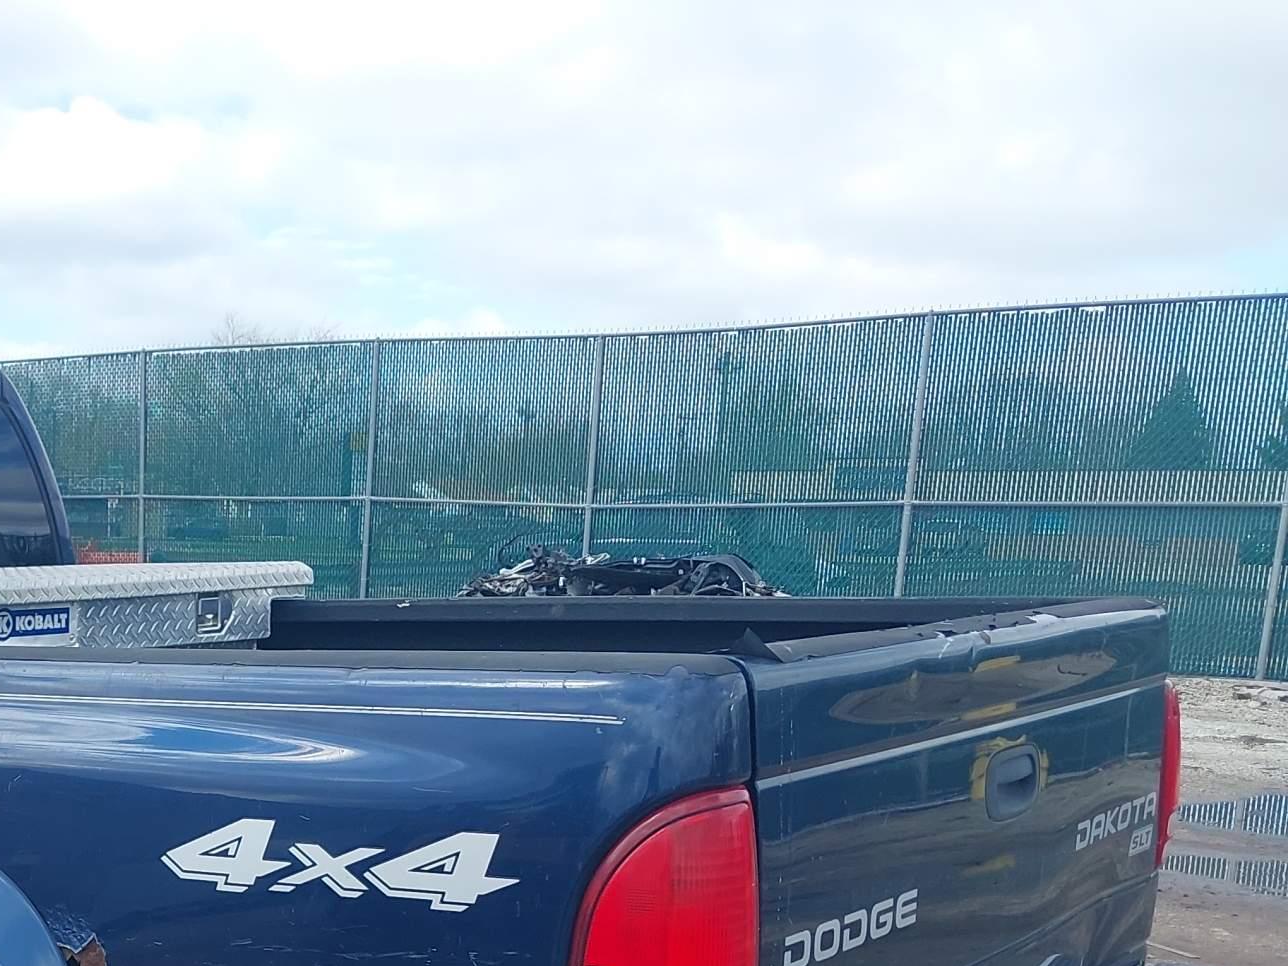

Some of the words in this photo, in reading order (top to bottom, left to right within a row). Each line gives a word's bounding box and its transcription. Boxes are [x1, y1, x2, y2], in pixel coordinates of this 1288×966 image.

[15, 612, 68, 632] KOBALT
[1075, 791, 1157, 852] DAKOTA
[1130, 829, 1152, 852] SLT
